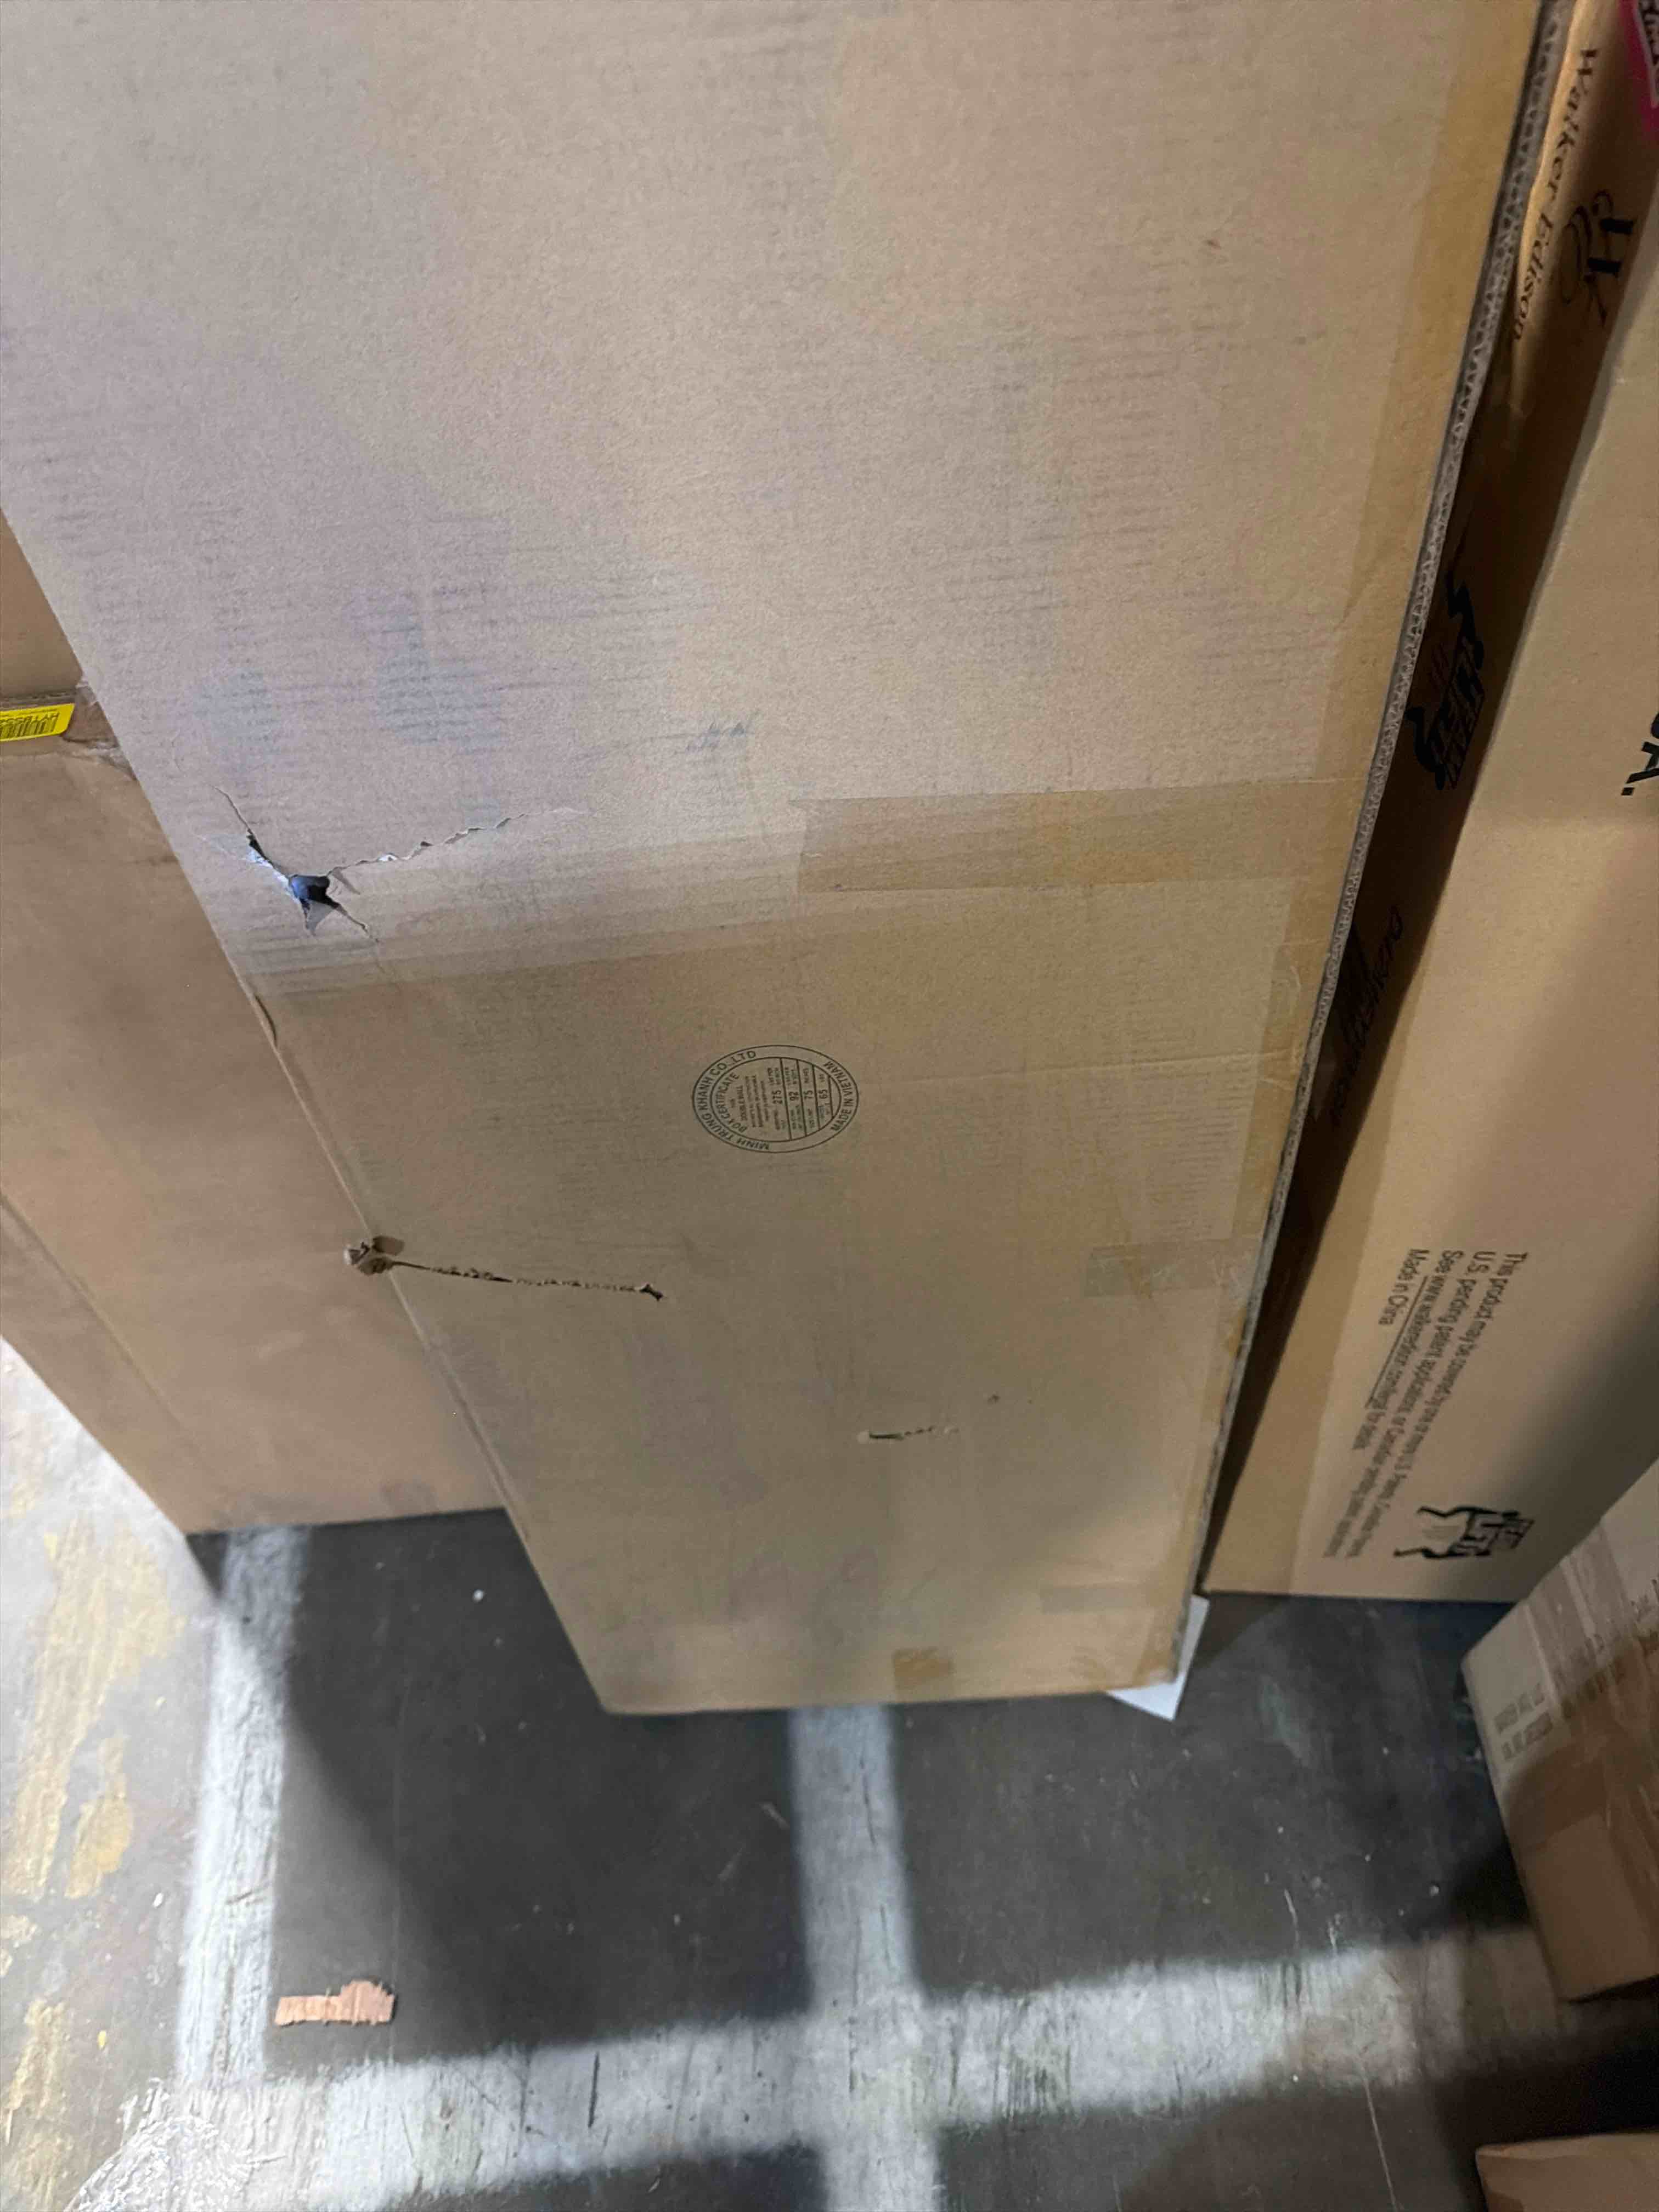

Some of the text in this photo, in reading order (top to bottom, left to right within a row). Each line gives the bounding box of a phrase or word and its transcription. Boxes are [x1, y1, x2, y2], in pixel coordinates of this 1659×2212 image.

[1547, 48, 1598, 201] Walker
[697, 1076, 713, 1111] KHANH
[715, 1072, 748, 1133] BOX CERTIFICATE
[772, 1090, 783, 1105] 275
[788, 1091, 799, 1102] 92
[803, 1090, 813, 1100] 75
[819, 1089, 828, 1099] 65
[823, 1061, 854, 1132] MADE IN VIETNAM
[702, 1113, 733, 1141] TRUNG
[737, 1137, 770, 1150] MINH
[1435, 1250, 1465, 1273] See
[1464, 1251, 1497, 1276] U.S.
[1496, 1251, 1529, 1277] This
[1377, 1249, 1430, 1326] Made in China
[1437, 1278, 1477, 1323] pending
[1474, 1277, 1509, 1319] product
